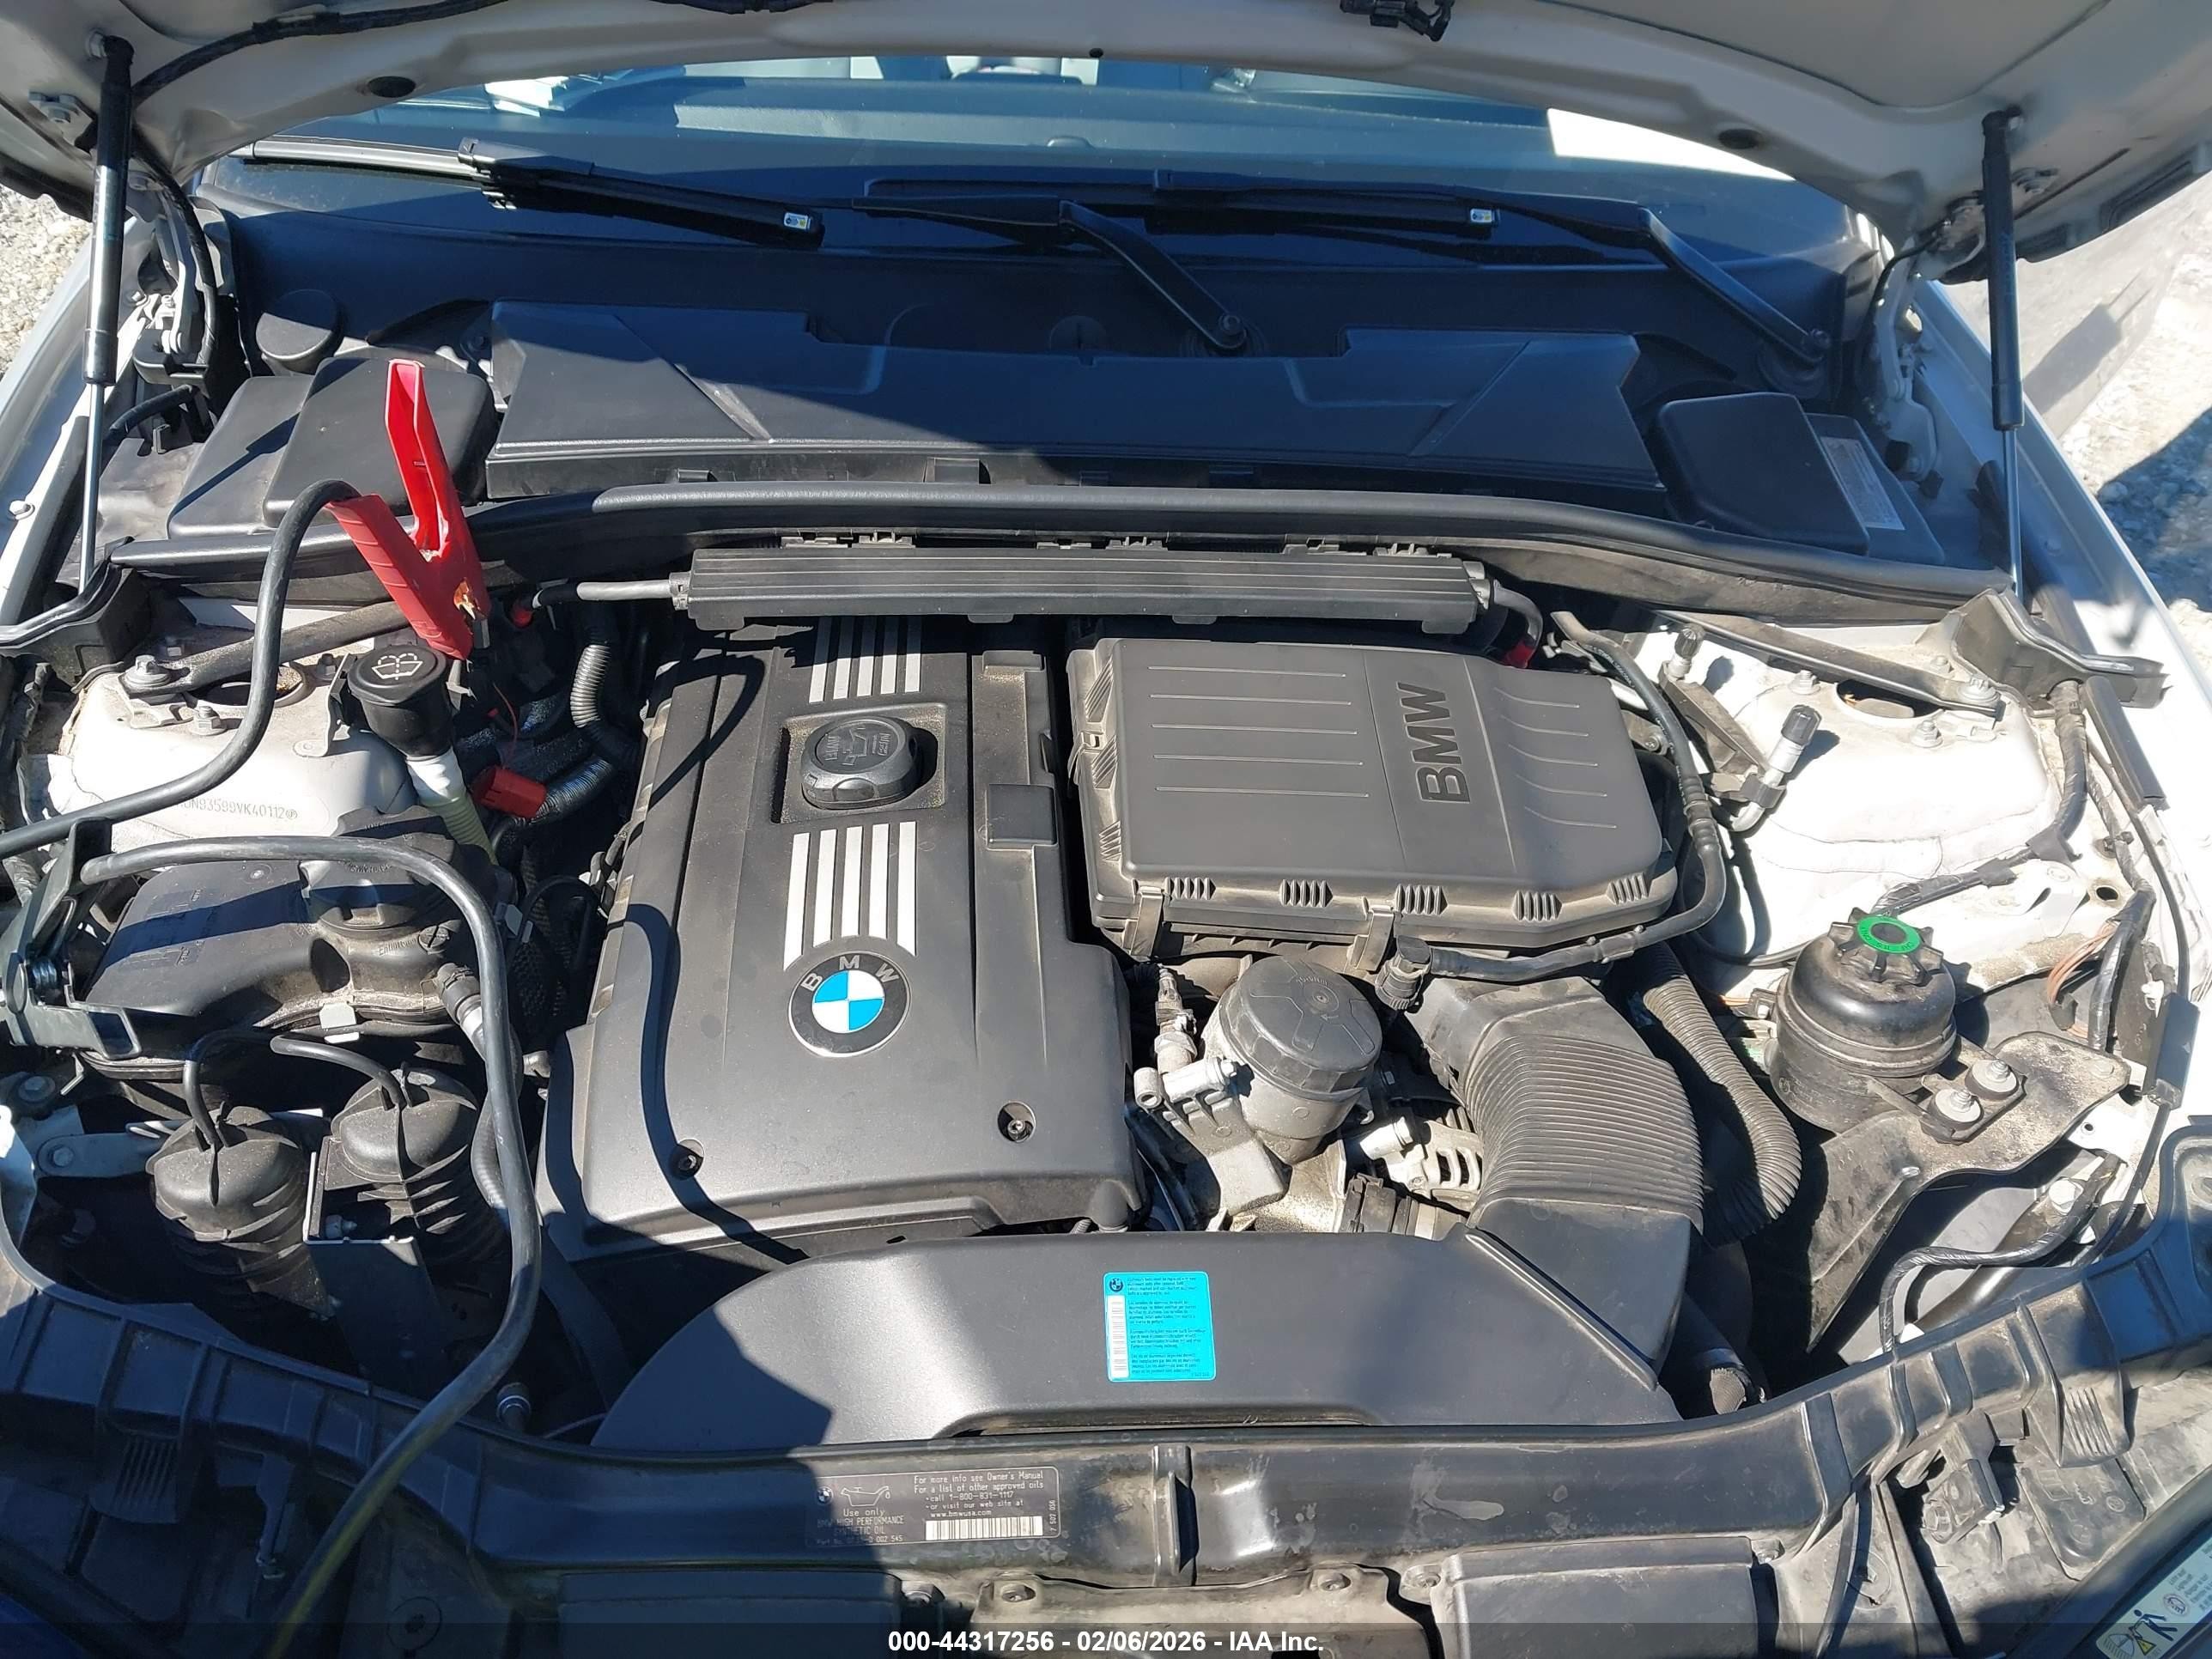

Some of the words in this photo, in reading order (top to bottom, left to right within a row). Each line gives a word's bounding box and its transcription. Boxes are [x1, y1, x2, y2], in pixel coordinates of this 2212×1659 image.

[1396, 681, 1470, 804] BMW
[180, 797, 285, 819] UN93599VK40112
[800, 955, 899, 991] BMW
[914, 1475, 927, 1484] For
[952, 1474, 967, 1483] info
[987, 1471, 1015, 1481] Owner's
[1018, 1470, 1043, 1480] Manual
[914, 1485, 927, 1493] For
[939, 1483, 952, 1492] list
[957, 1483, 964, 1492] of
[969, 1482, 988, 1492] other
[993, 1481, 1025, 1492] approved
[1029, 1480, 1044, 1489] oils
[842, 1508, 860, 1516] Use
[865, 1507, 885, 1517] only
[942, 1501, 960, 1510] visit
[857, 1515, 904, 1525] PERFORMANCE
[874, 1526, 887, 1534] OIL
